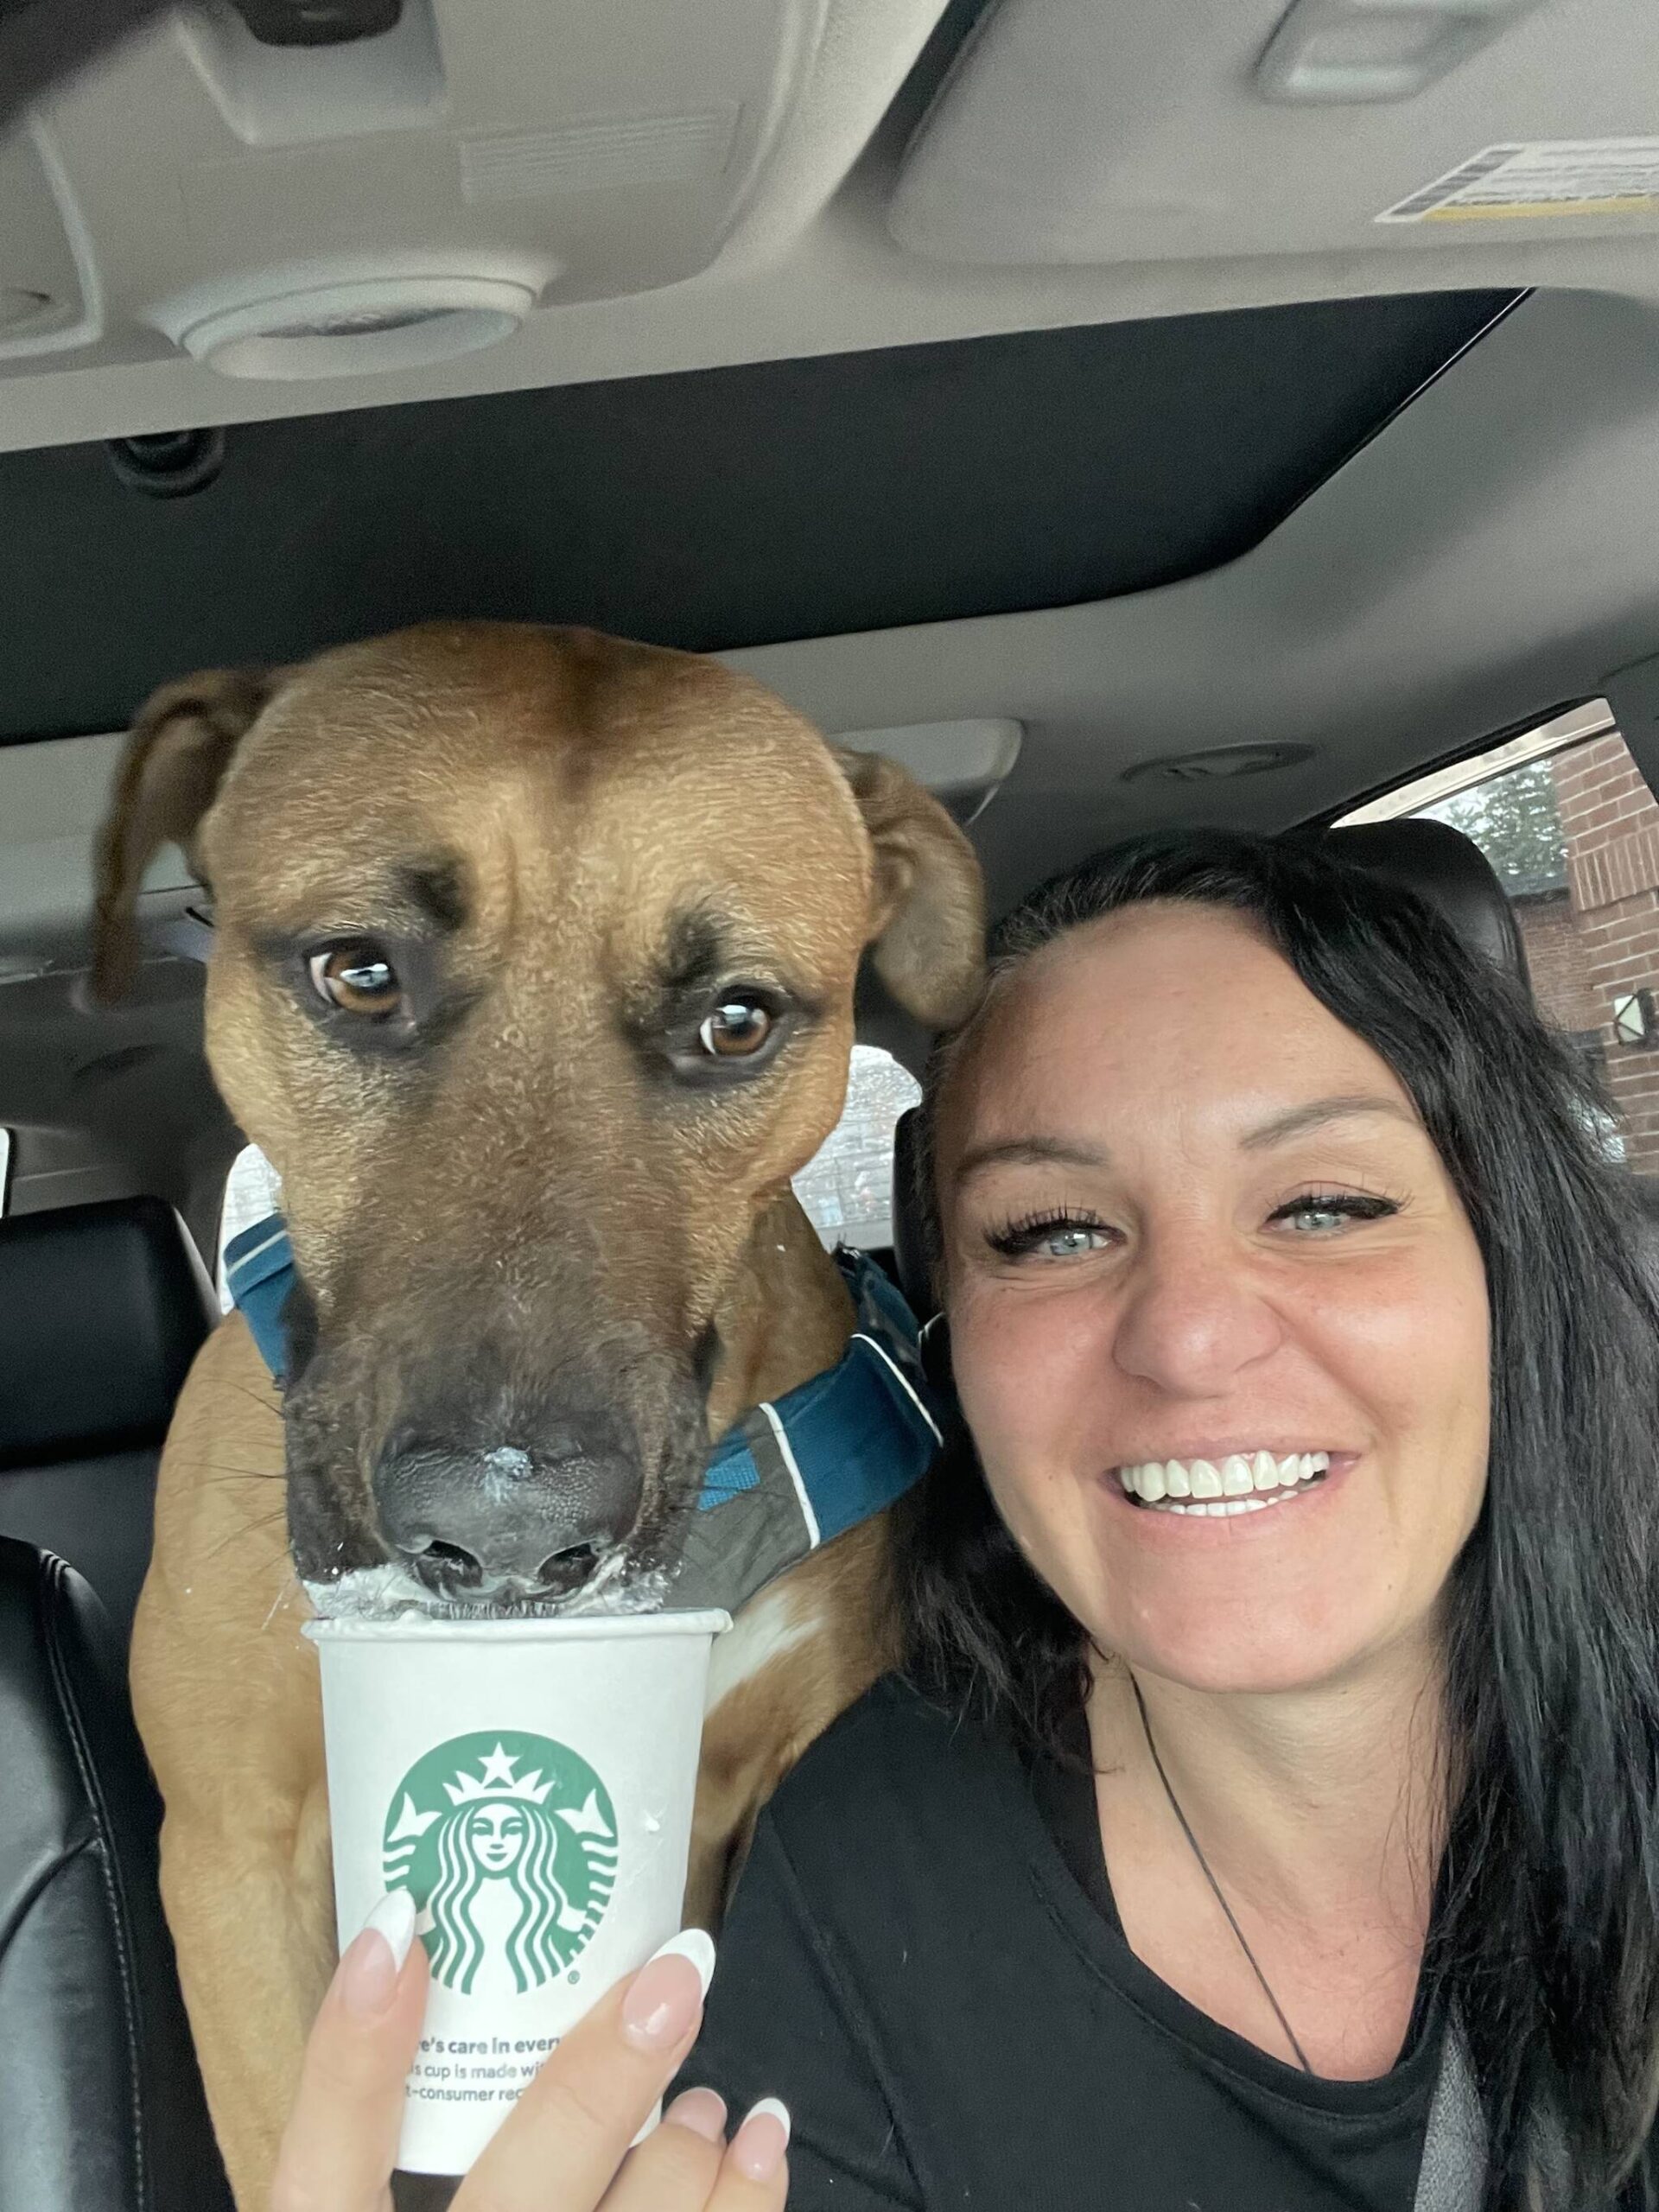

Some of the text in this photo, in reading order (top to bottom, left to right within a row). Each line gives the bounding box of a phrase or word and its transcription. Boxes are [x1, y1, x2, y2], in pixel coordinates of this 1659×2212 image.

[418, 2037, 445, 2053] e's
[448, 2040, 488, 2055] care
[424, 2065, 451, 2082] cup
[454, 2063, 467, 2079] is
[471, 2063, 517, 2079] made
[520, 2061, 544, 2077] wi
